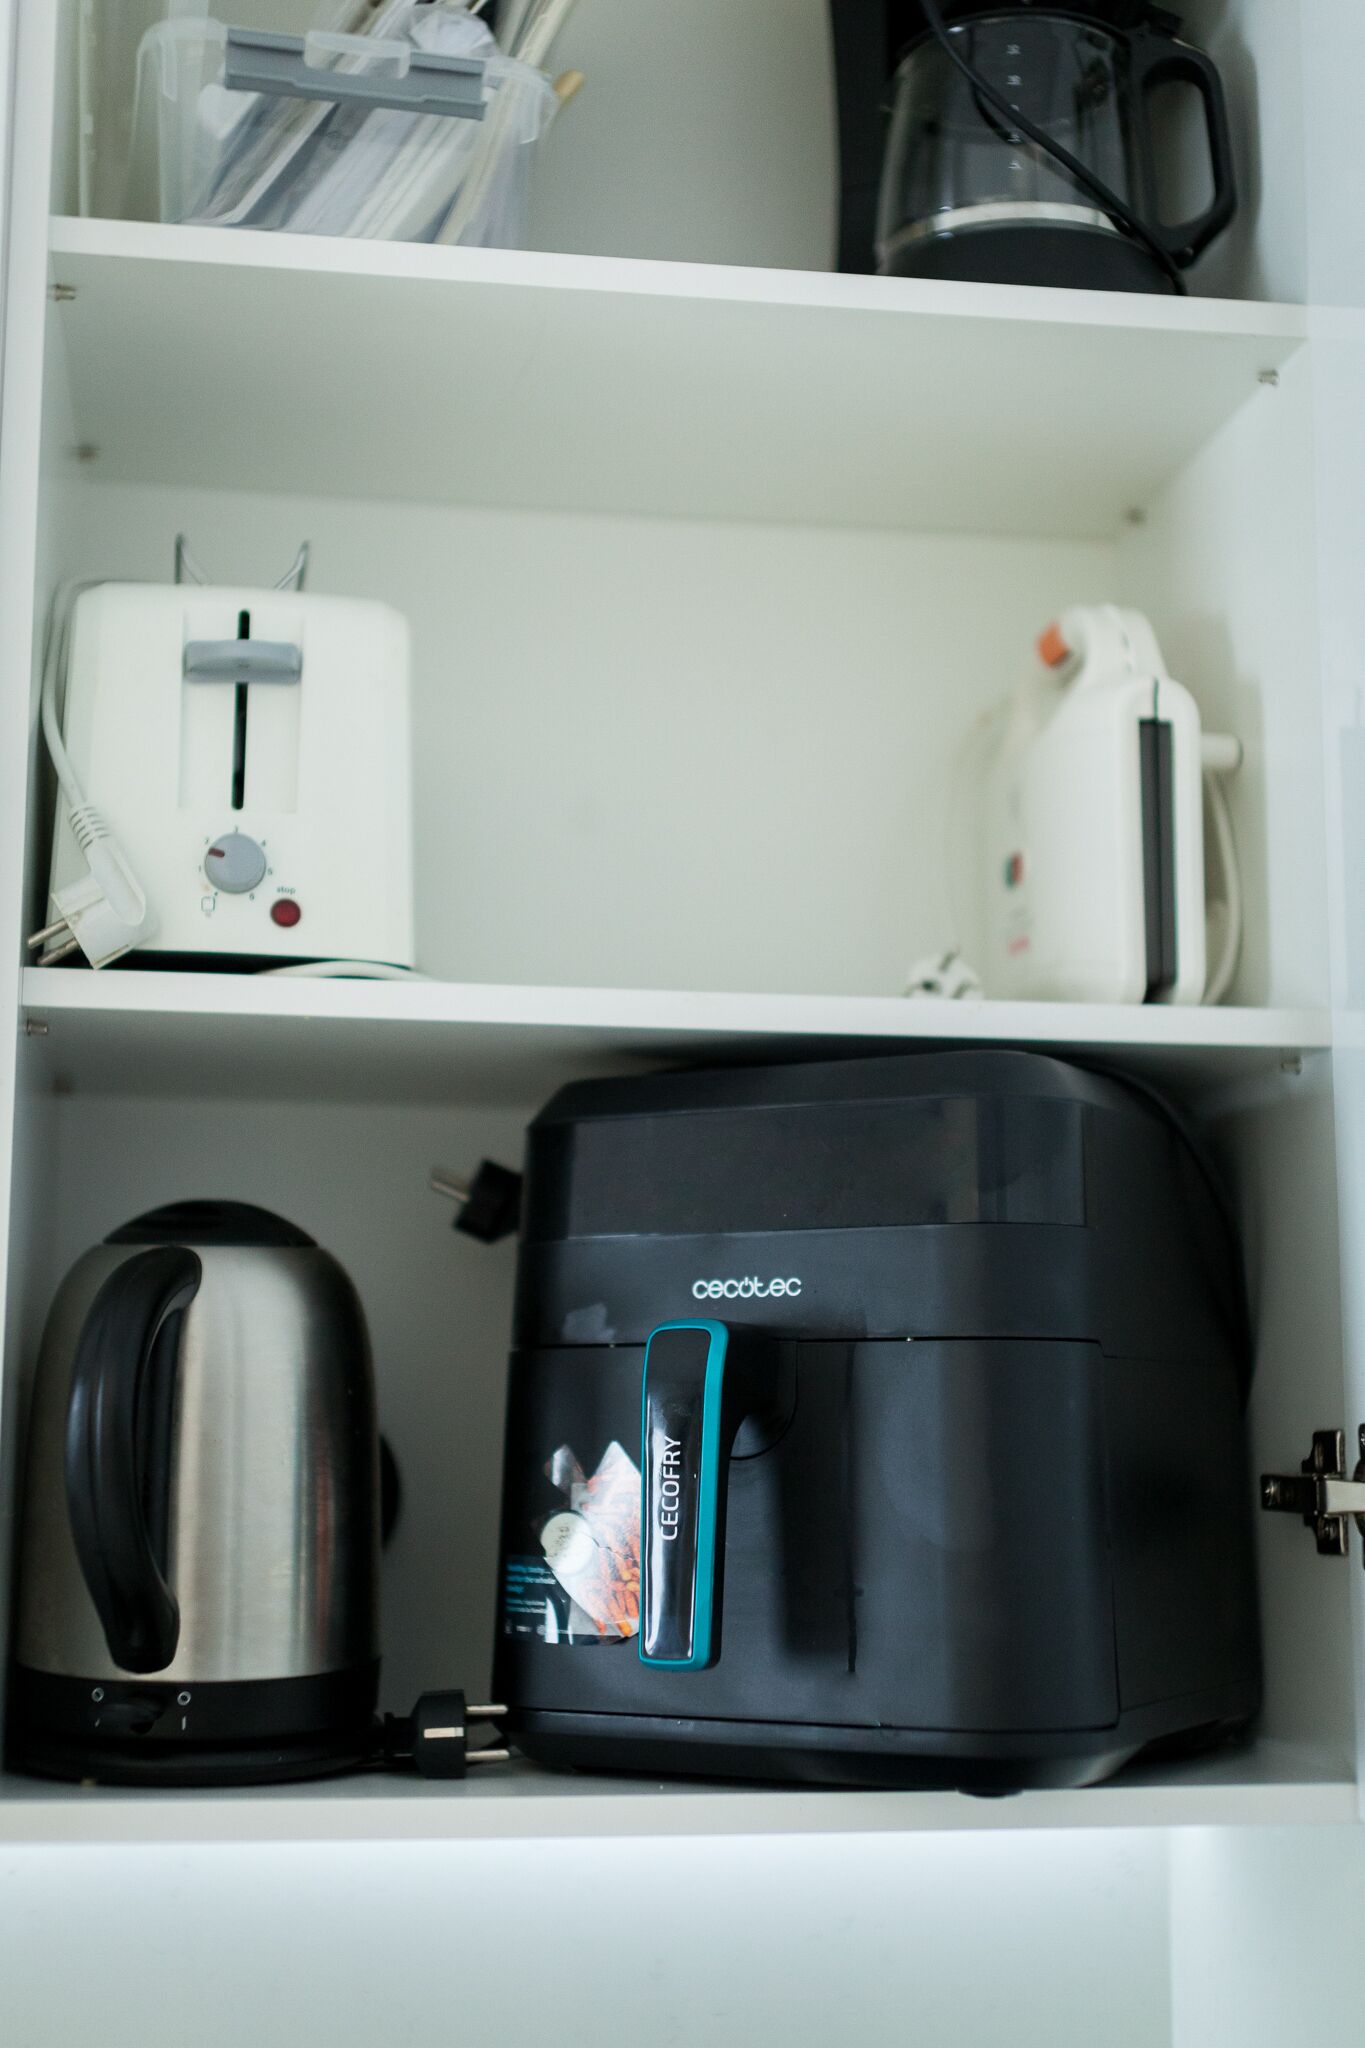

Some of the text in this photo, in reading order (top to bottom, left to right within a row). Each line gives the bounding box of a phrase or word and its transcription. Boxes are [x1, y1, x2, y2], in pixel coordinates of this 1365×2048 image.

[276, 885, 297, 896] stop
[691, 1276, 802, 1299] cecotec
[660, 1435, 681, 1541] CECOFRY
